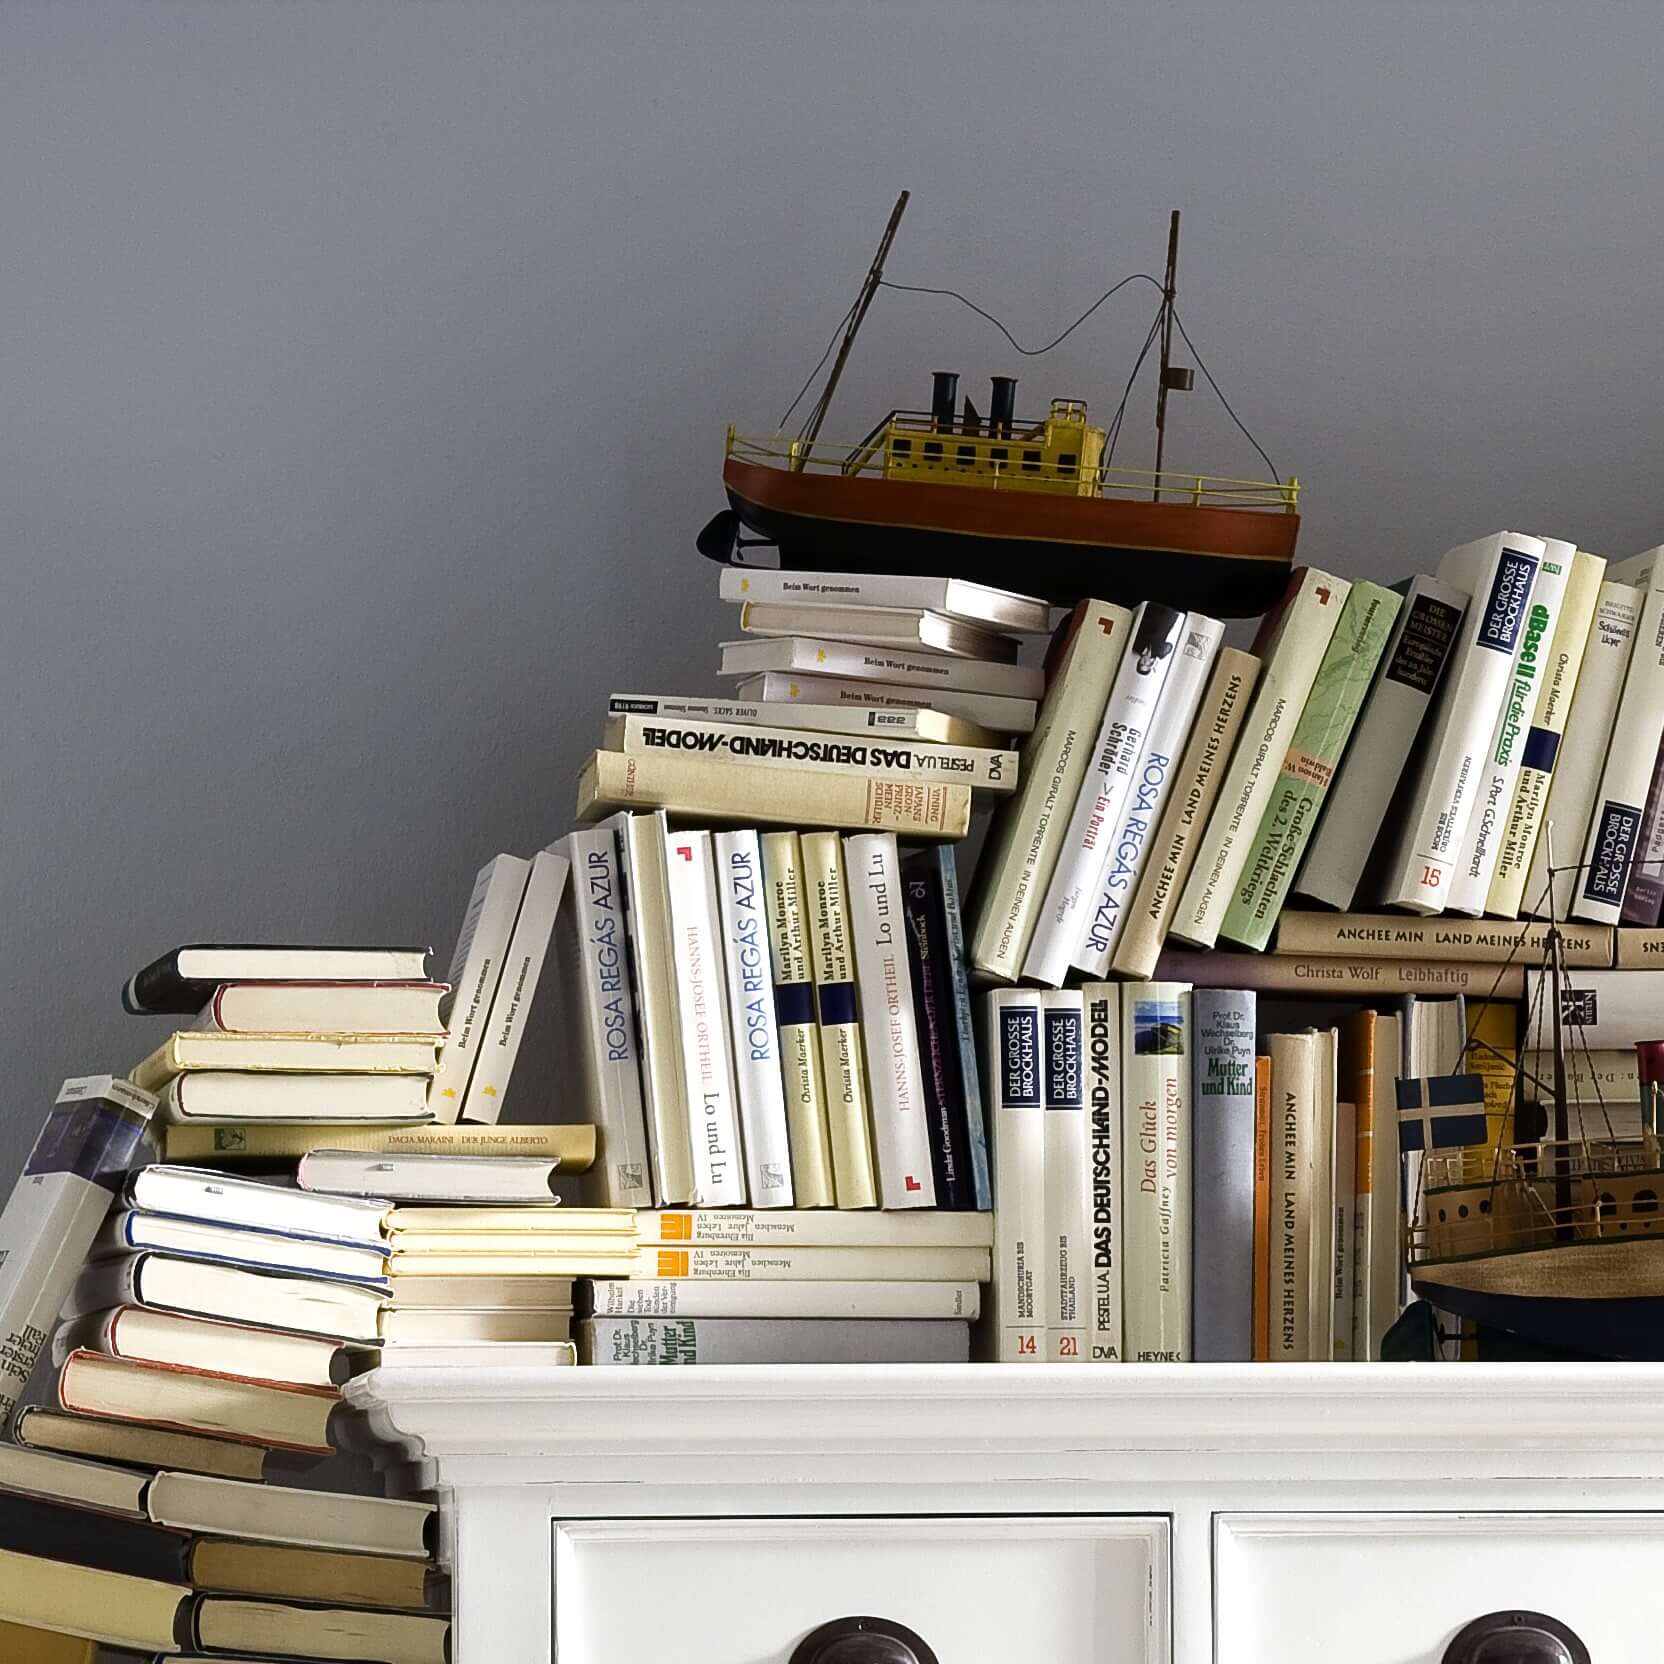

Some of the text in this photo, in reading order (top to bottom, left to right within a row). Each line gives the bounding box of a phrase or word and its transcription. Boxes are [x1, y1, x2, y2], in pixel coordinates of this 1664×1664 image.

[802, 583, 820, 593] Wort
[870, 750, 911, 769] DAS
[938, 757, 975, 772] PESTEL
[989, 754, 1002, 780] DVA
[998, 730, 1076, 958] MARCOS GIRALT TORRENTE IN DEINEN AUGEN
[1086, 752, 1169, 952] ROSA REGÁS AZUR
[1241, 790, 1296, 905] des 2. Weltkriegs
[1255, 797, 1313, 919] Große Schlachten
[1422, 865, 1440, 887] 15
[776, 881, 793, 981] Marilyn Monroe
[786, 867, 805, 980] und Arthur Miller
[869, 854, 892, 945] Lo und Lu
[589, 851, 629, 1061] ROSA REGÁS AZUR
[1295, 964, 1384, 981] Christa Wolf
[1398, 968, 1469, 985] Leibhaftig
[883, 953, 911, 1111] HANNS-JOSEF ORTHEIL
[1208, 1059, 1248, 1076] Mutter
[1164, 1077, 1181, 1178] von morgen
[1202, 1079, 1253, 1095] und Kind
[1139, 1101, 1156, 1193] Das Glück
[1159, 1186, 1172, 1292] Patricia Gaffney
[1018, 1336, 1036, 1353] 14
[1060, 1338, 1078, 1355] 21
